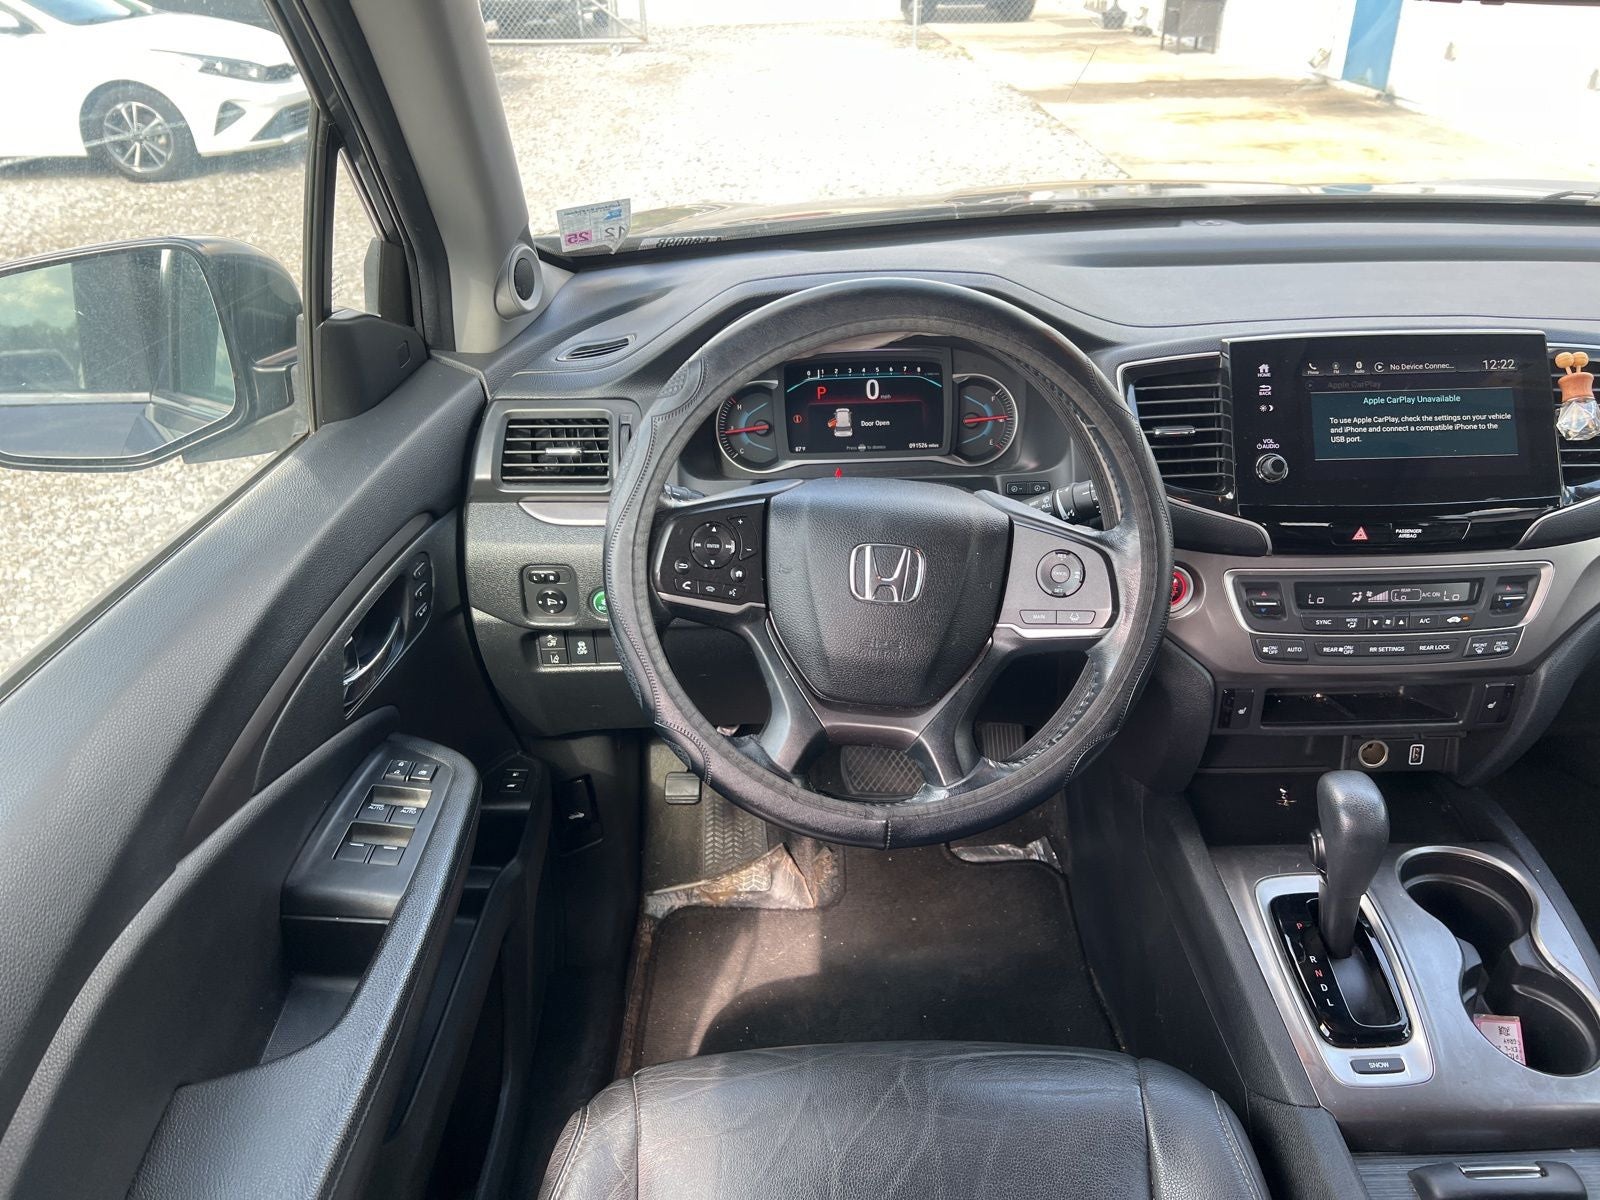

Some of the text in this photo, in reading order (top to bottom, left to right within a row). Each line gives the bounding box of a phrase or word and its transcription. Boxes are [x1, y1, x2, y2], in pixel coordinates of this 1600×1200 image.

[1482, 359, 1516, 370] 12:22
[816, 386, 827, 400] P
[866, 379, 880, 400] 0
[1363, 395, 1461, 405] Apple CarPlay Unavailable
[1352, 416, 1372, 424] Apple
[1372, 416, 1400, 424] CarPlay,
[1434, 414, 1461, 422] settings
[1472, 414, 1487, 422] your
[1487, 412, 1512, 420] vehicle
[1415, 424, 1454, 432] compatible
[1346, 435, 1363, 443] port.
[1309, 955, 1317, 964] R
[1315, 968, 1324, 977] N
[1320, 983, 1329, 992] D
[1326, 998, 1335, 1007] L
[1368, 1061, 1390, 1069] SNOW
